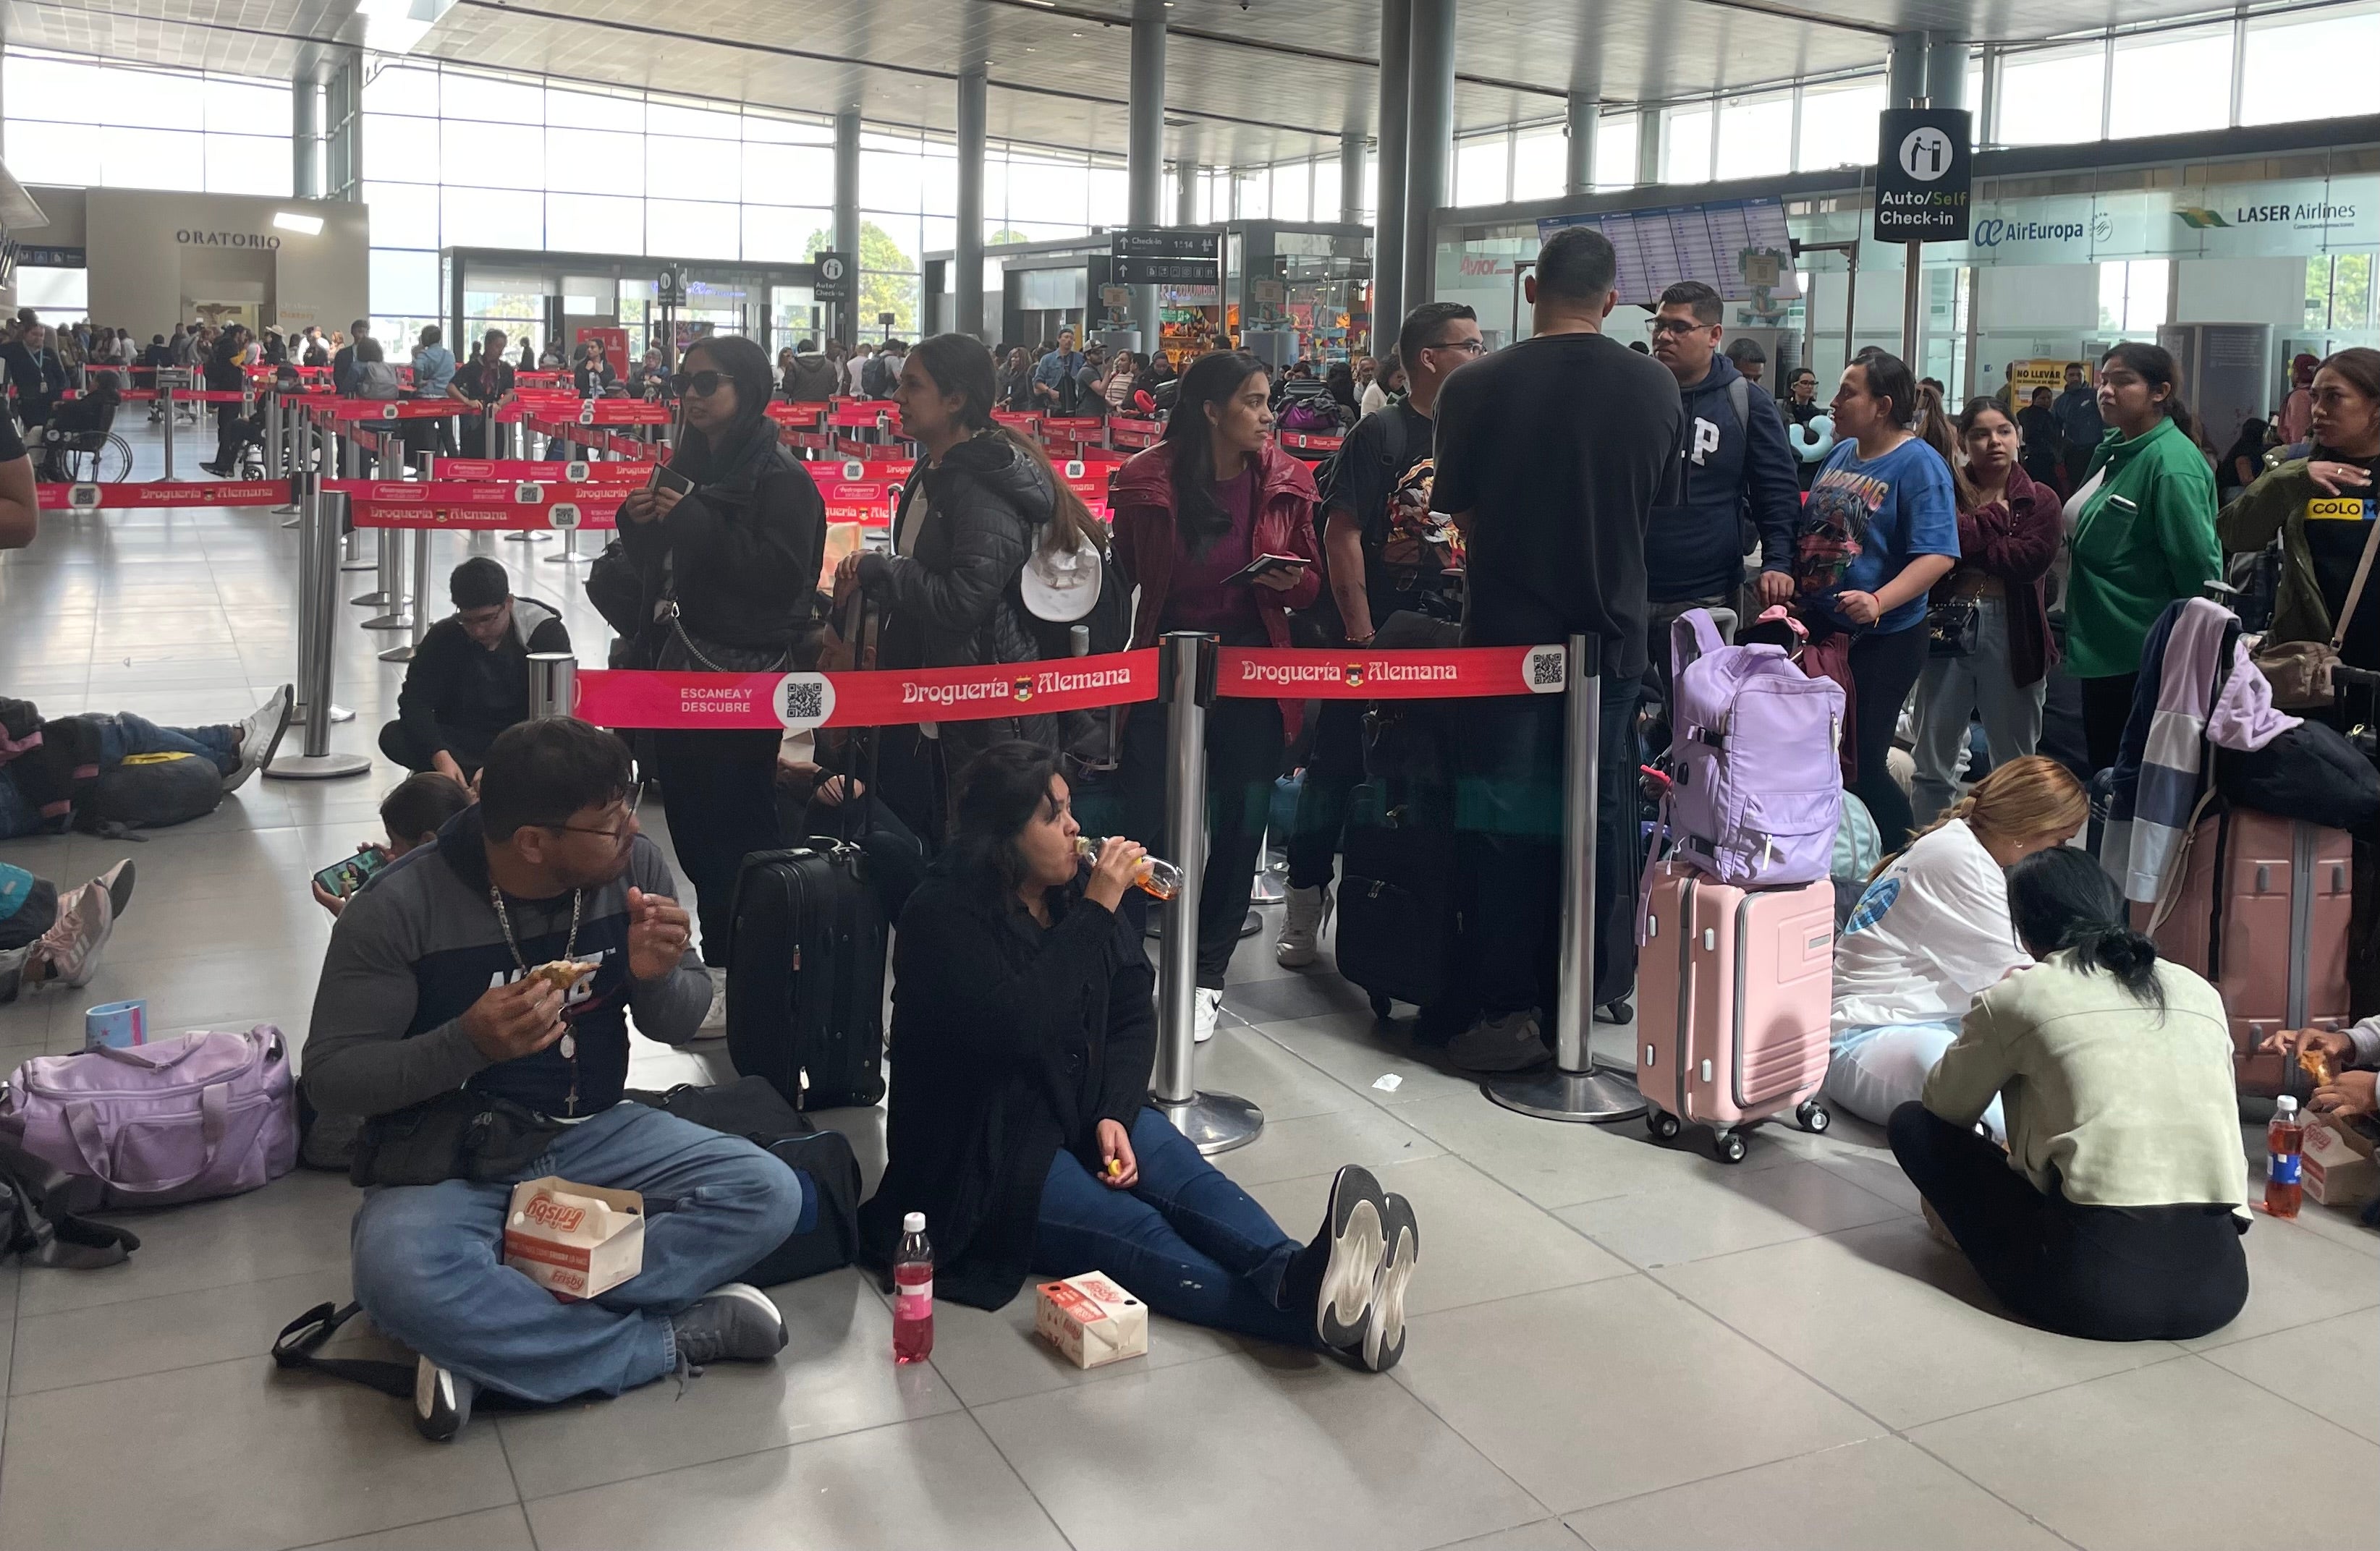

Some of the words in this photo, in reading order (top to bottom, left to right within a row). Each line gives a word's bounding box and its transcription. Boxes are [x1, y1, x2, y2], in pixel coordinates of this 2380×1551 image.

[1881, 190, 1967, 206] Auto/Self
[1879, 211, 1954, 226] Check-in
[2237, 205, 2290, 223] LASER
[2294, 202, 2356, 220] Airlines
[177, 229, 281, 250] ORATORIO
[2005, 222, 2083, 242] AirEuropa
[1460, 255, 1499, 276] Avior
[216, 486, 273, 498] Alemana
[449, 507, 508, 520] Alemana
[1242, 661, 1341, 685] Droguería
[1368, 661, 1457, 680] Alemana
[681, 688, 741, 699] ESCANEA
[744, 688, 753, 699] Y
[902, 679, 1009, 705] Droguería
[1037, 668, 1130, 693] Alemana
[681, 702, 750, 713] DESCUBRE
[525, 1193, 585, 1233] Frisby
[551, 1270, 585, 1291] Frisby
